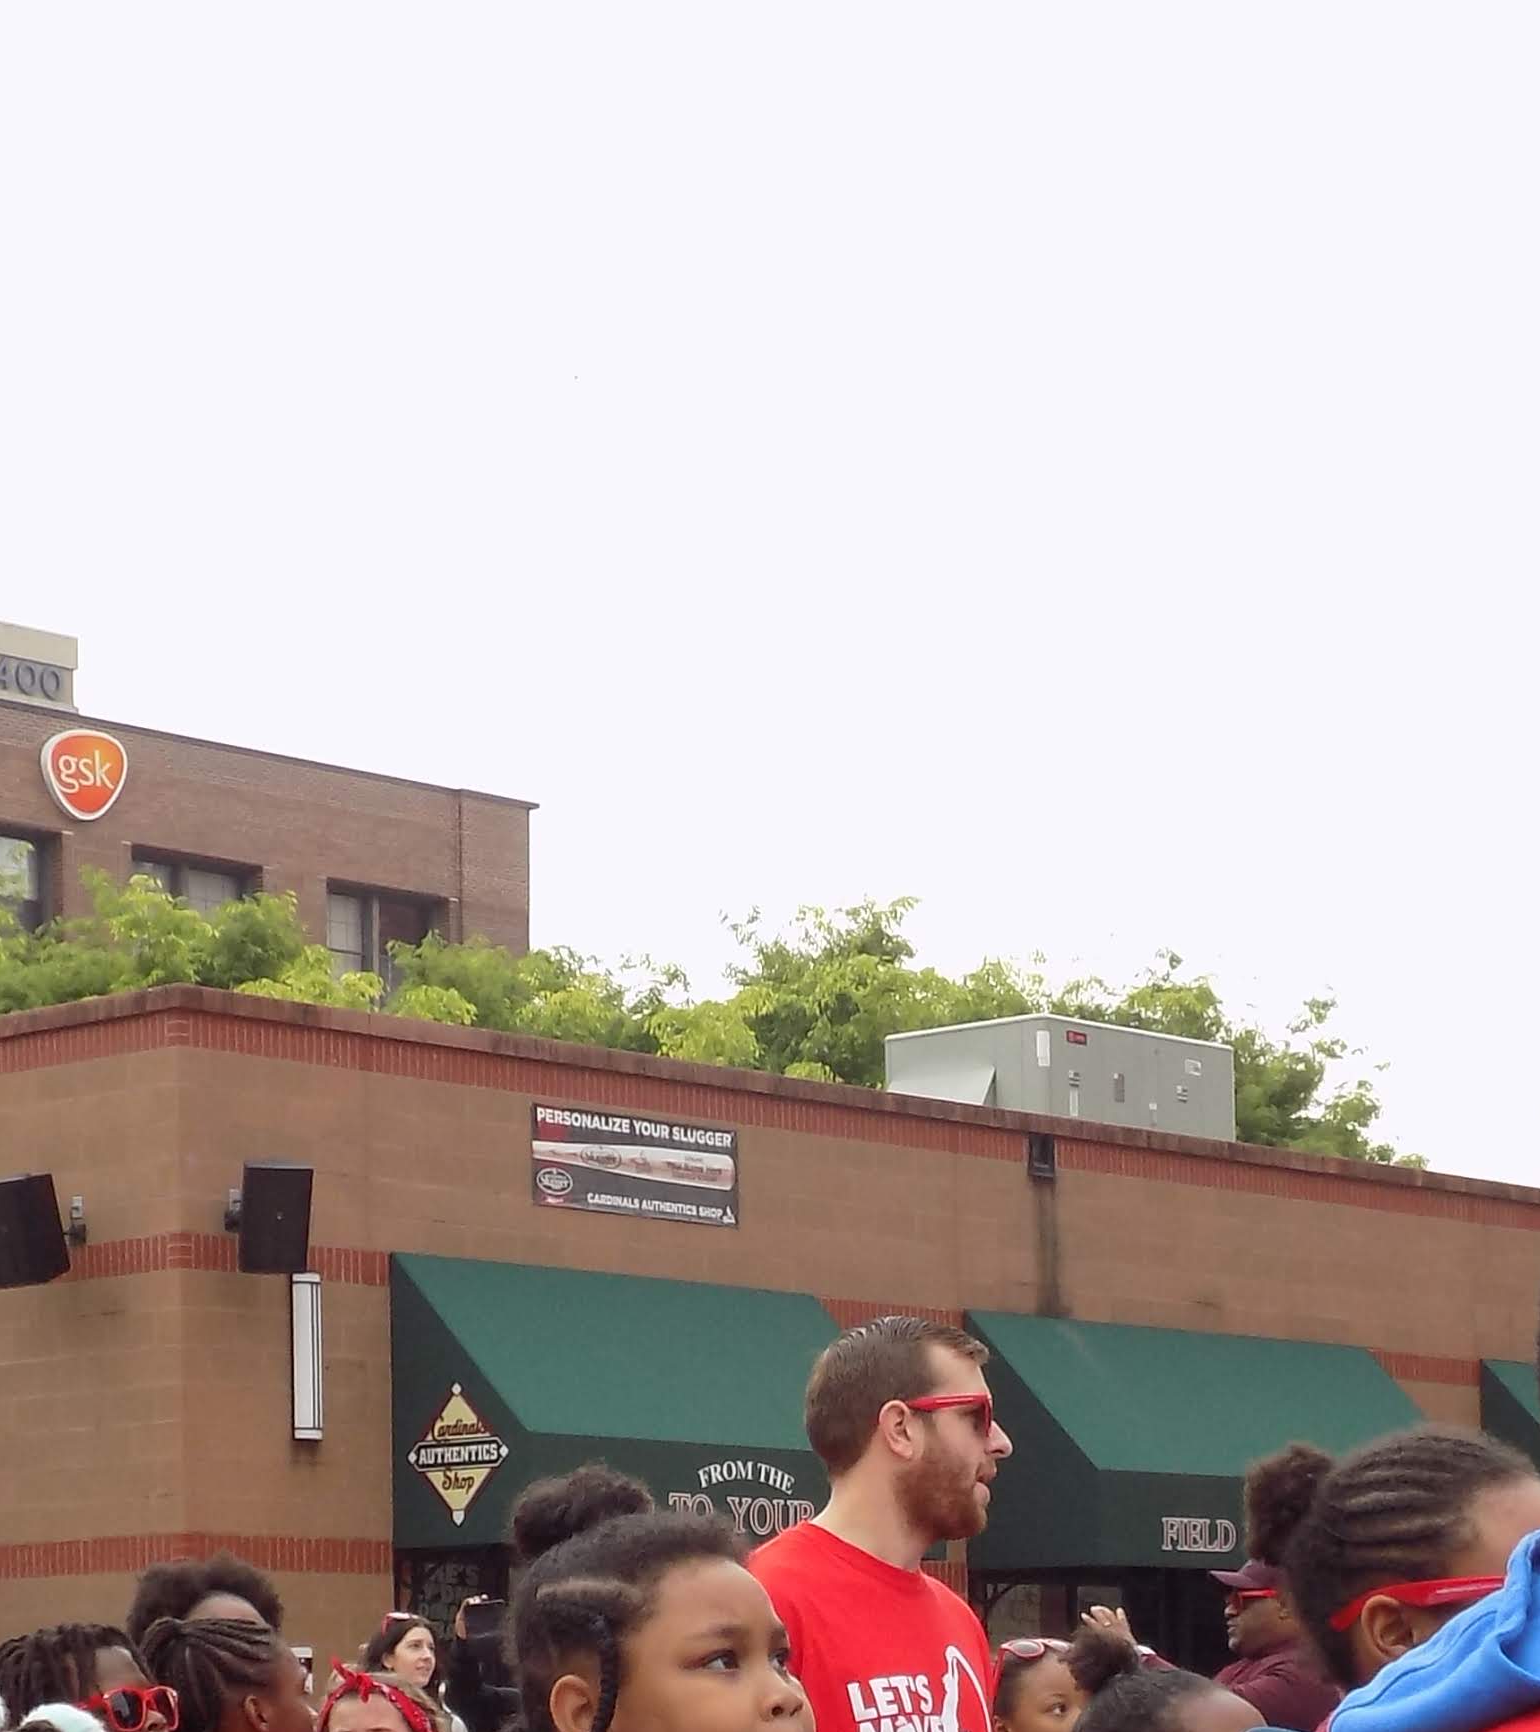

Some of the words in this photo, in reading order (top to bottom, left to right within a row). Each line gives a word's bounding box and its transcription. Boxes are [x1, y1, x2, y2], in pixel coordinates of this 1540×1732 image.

[58, 750, 115, 794] gsk
[536, 1106, 631, 1133] PERSONALIZE
[633, 1120, 670, 1139] YOUR
[672, 1126, 732, 1148] SLUGGER
[587, 1192, 640, 1210] CARDINALS
[641, 1199, 697, 1216] AUTHENTICS
[698, 1204, 723, 1220] SHOP
[418, 1443, 499, 1466] AUTHENTICS
[442, 1467, 475, 1495] Shop
[697, 1460, 754, 1489] FROM
[757, 1462, 795, 1495] THE
[1161, 1516, 1237, 1553] FIELD
[846, 1674, 934, 1723] LET'S
